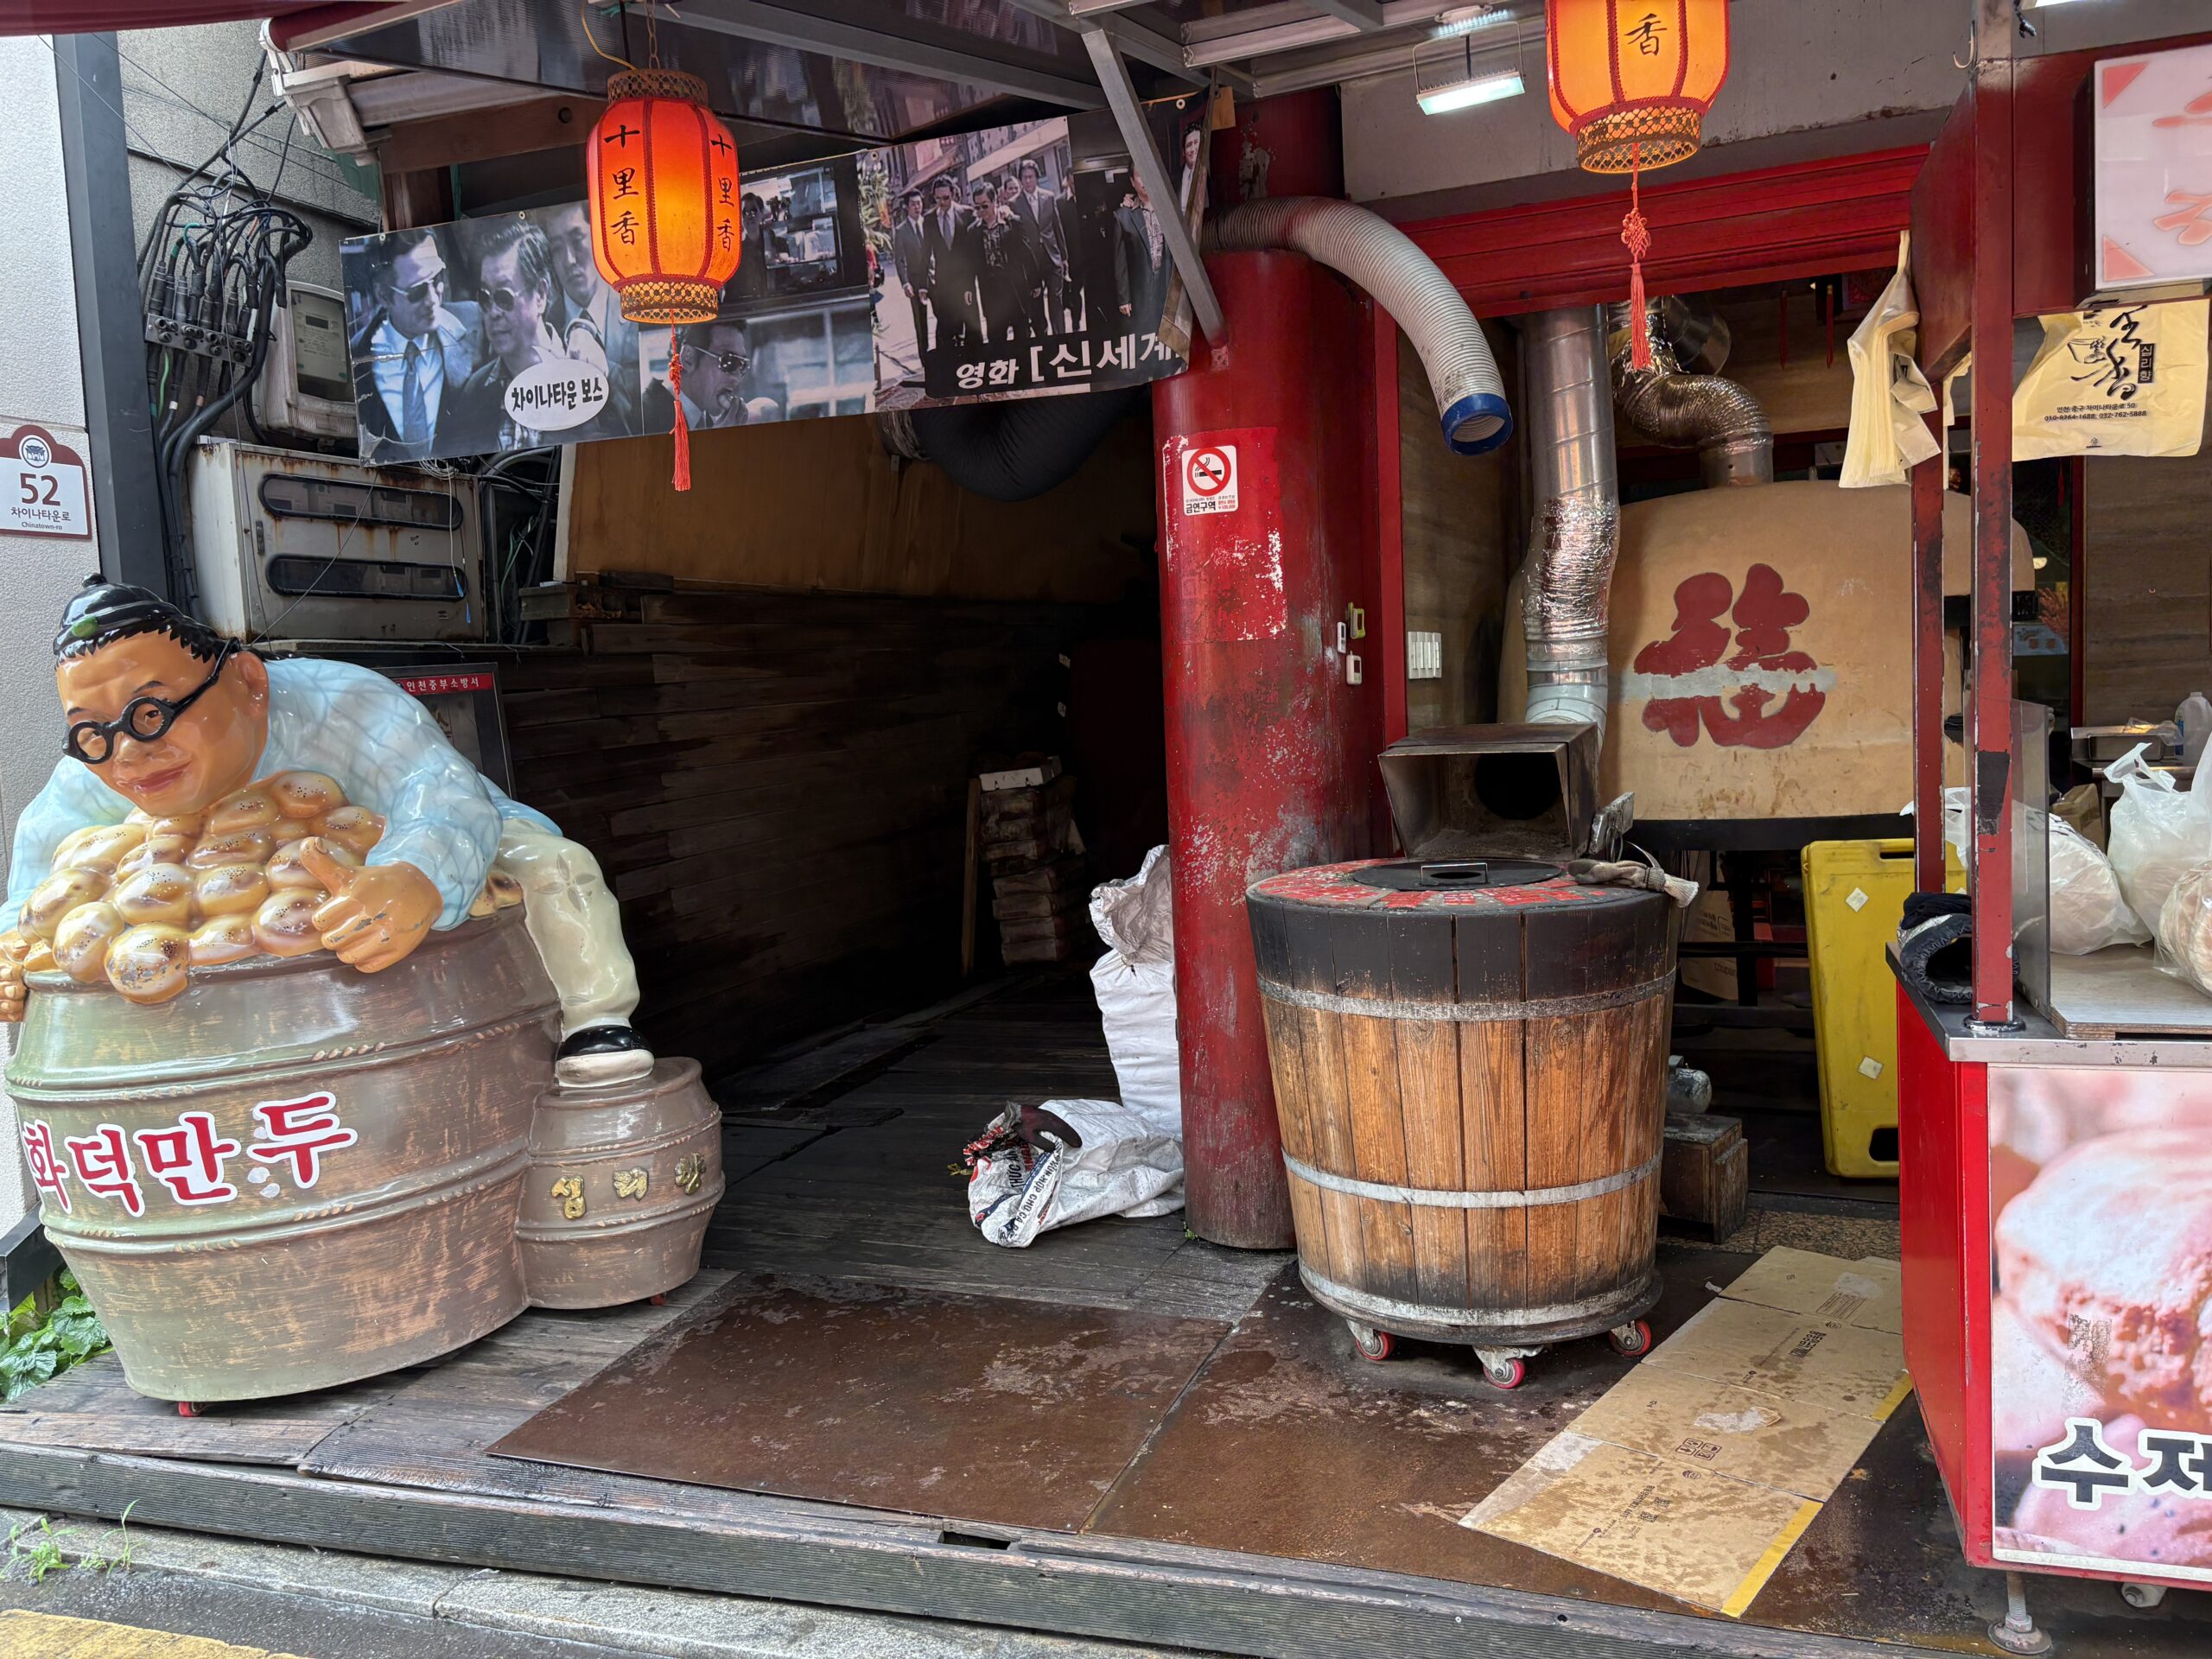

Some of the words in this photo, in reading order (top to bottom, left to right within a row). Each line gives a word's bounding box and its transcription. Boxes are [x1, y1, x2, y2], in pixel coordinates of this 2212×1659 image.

[604, 124, 640, 245] 十里香
[709, 134, 734, 252] 十里香
[956, 359, 1020, 389] 영화
[2139, 346, 2152, 382] 십리향
[512, 380, 577, 411] 차이나타운
[582, 377, 603, 403] 보스
[20, 473, 61, 506] 52
[10, 506, 72, 523] 차이나타운로
[1185, 500, 1217, 514] 금연구역
[21, 521, 63, 531] Chinatown-ro
[406, 677, 480, 692] 인천중부소방서
[22, 1094, 353, 1214] 화덕만두
